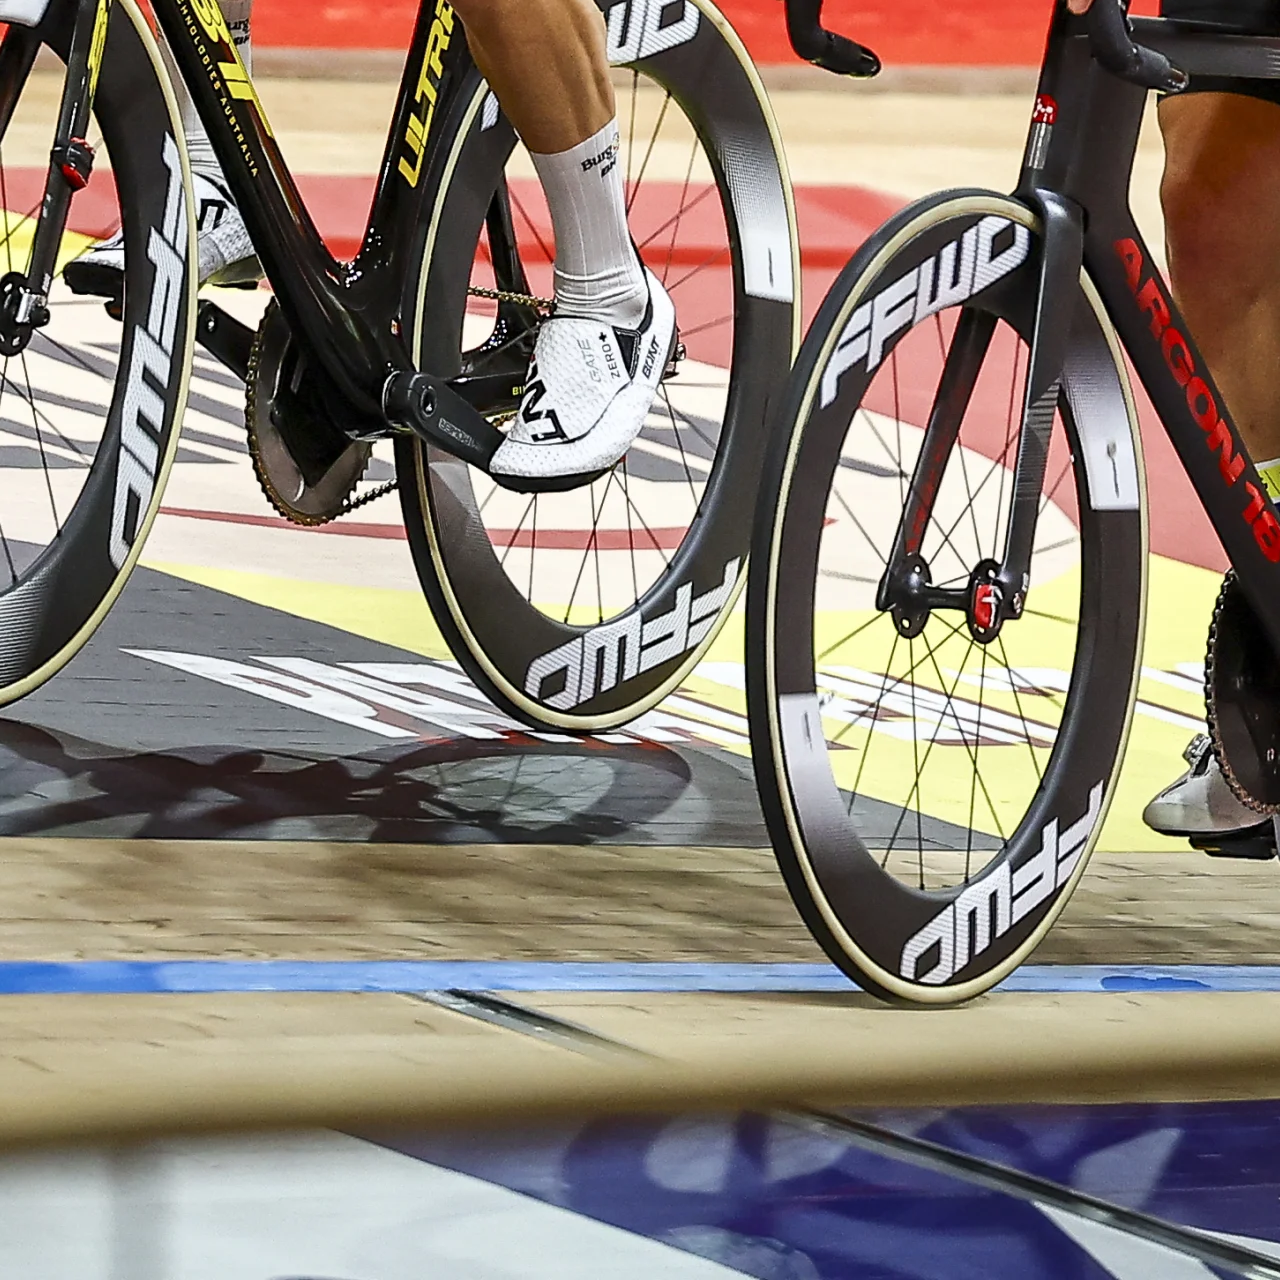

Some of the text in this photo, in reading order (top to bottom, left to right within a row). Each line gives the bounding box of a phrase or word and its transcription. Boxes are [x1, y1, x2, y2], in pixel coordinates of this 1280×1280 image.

[219, 96, 260, 178] AUSTRALIA
[108, 131, 188, 573] FFWD
[642, 334, 662, 380] BONT
[819, 213, 1030, 410] FFWD
[1113, 237, 1246, 488] ARGON
[900, 777, 1106, 987] FFWD
